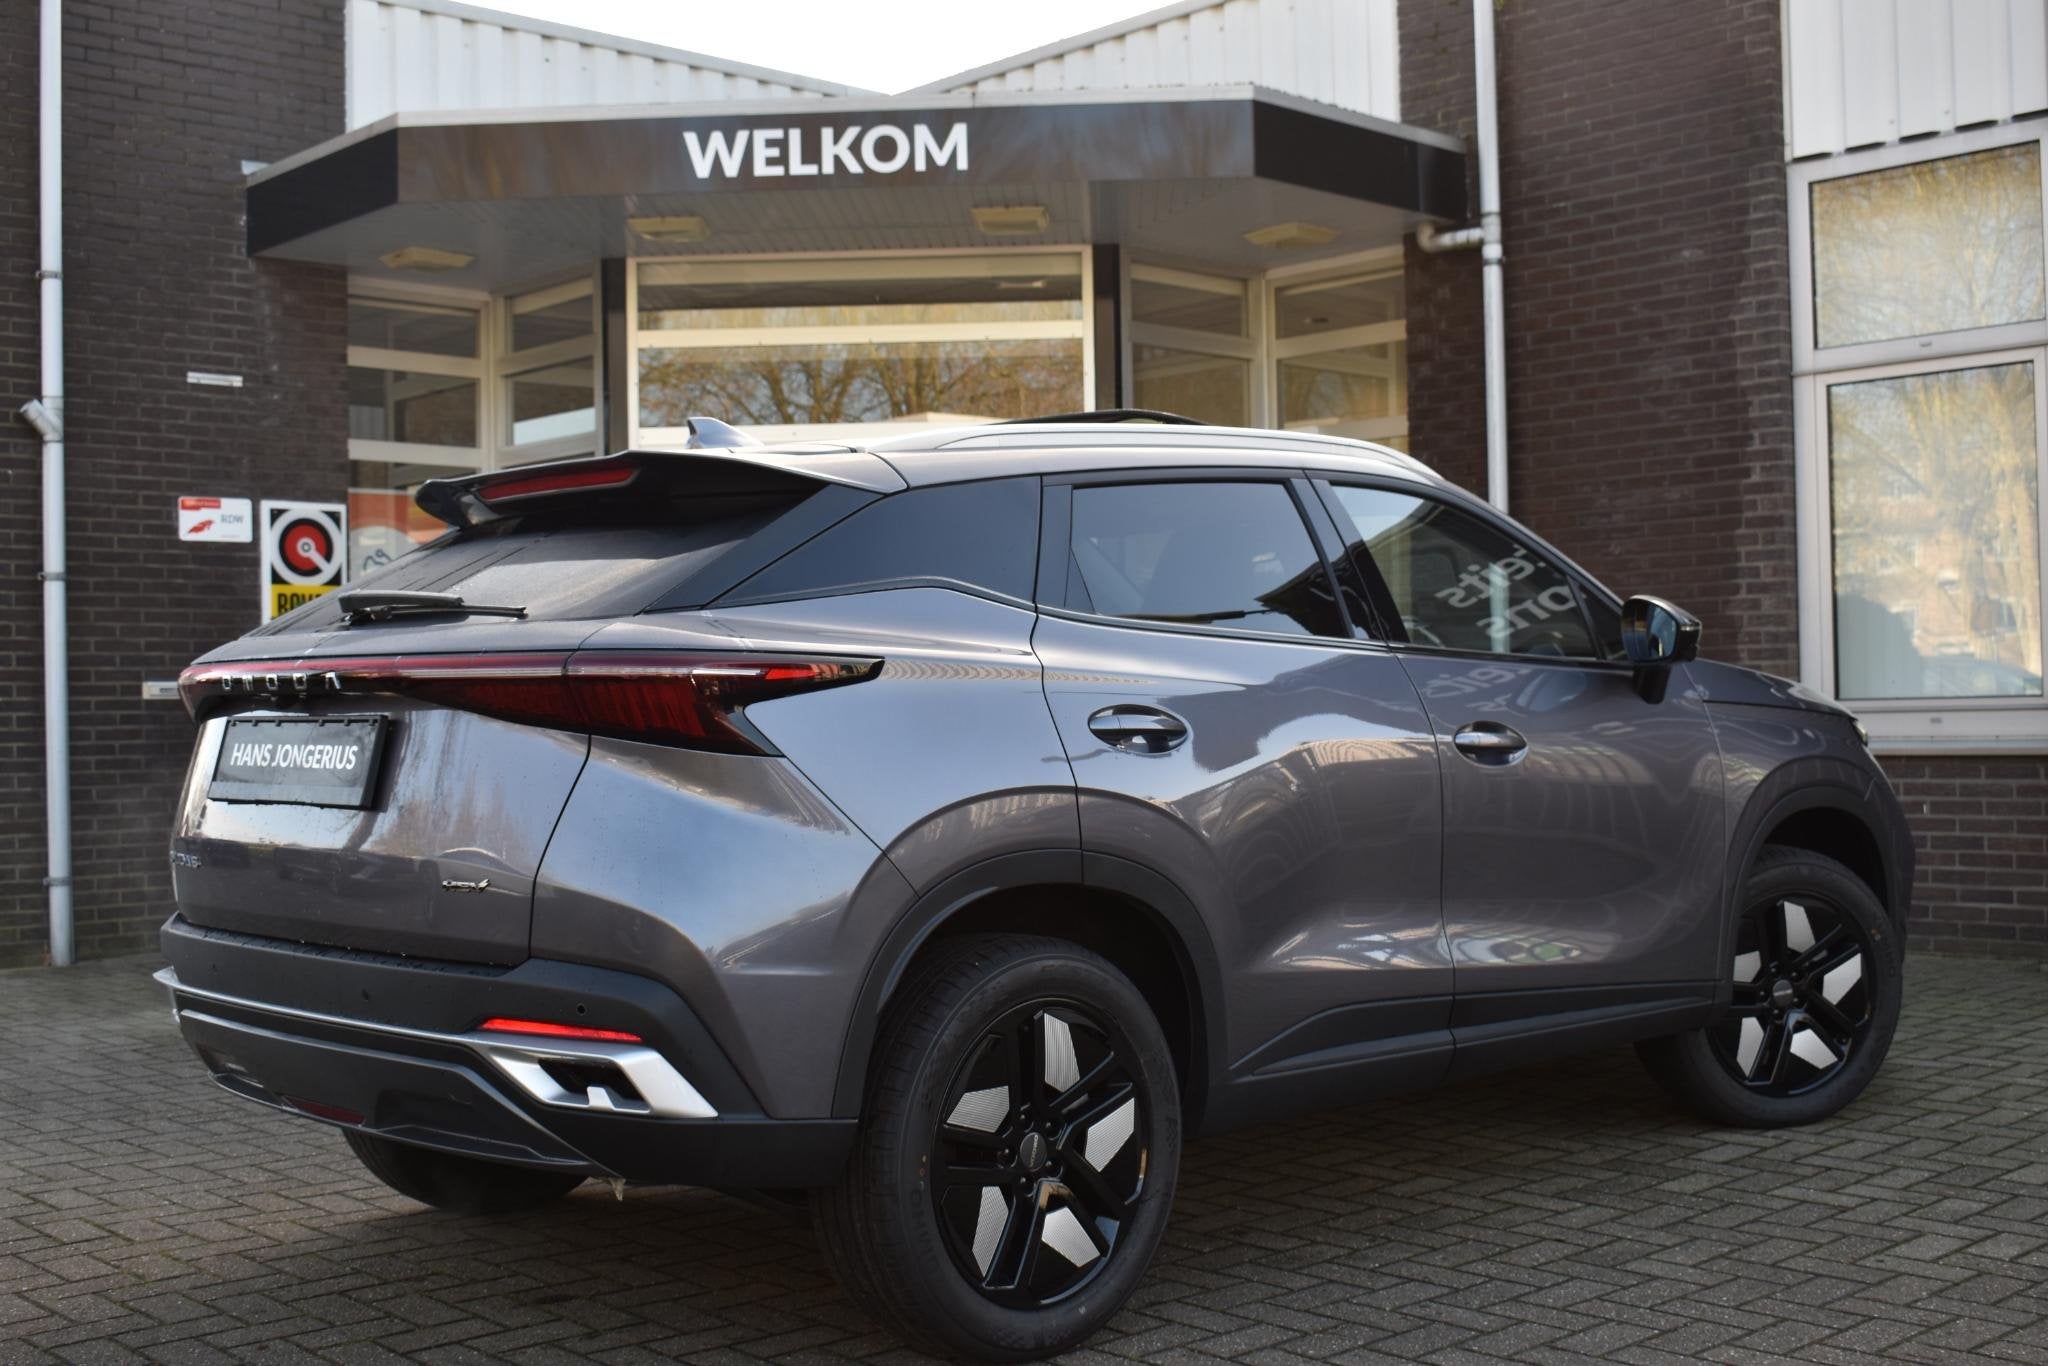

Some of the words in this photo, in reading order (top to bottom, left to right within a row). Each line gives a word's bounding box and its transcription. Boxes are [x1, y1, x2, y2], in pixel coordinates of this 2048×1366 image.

[682, 122, 969, 179] WELKOM
[277, 592, 322, 614] BOV
[230, 743, 271, 767] HANS
[272, 744, 359, 770] JONGERIUS
